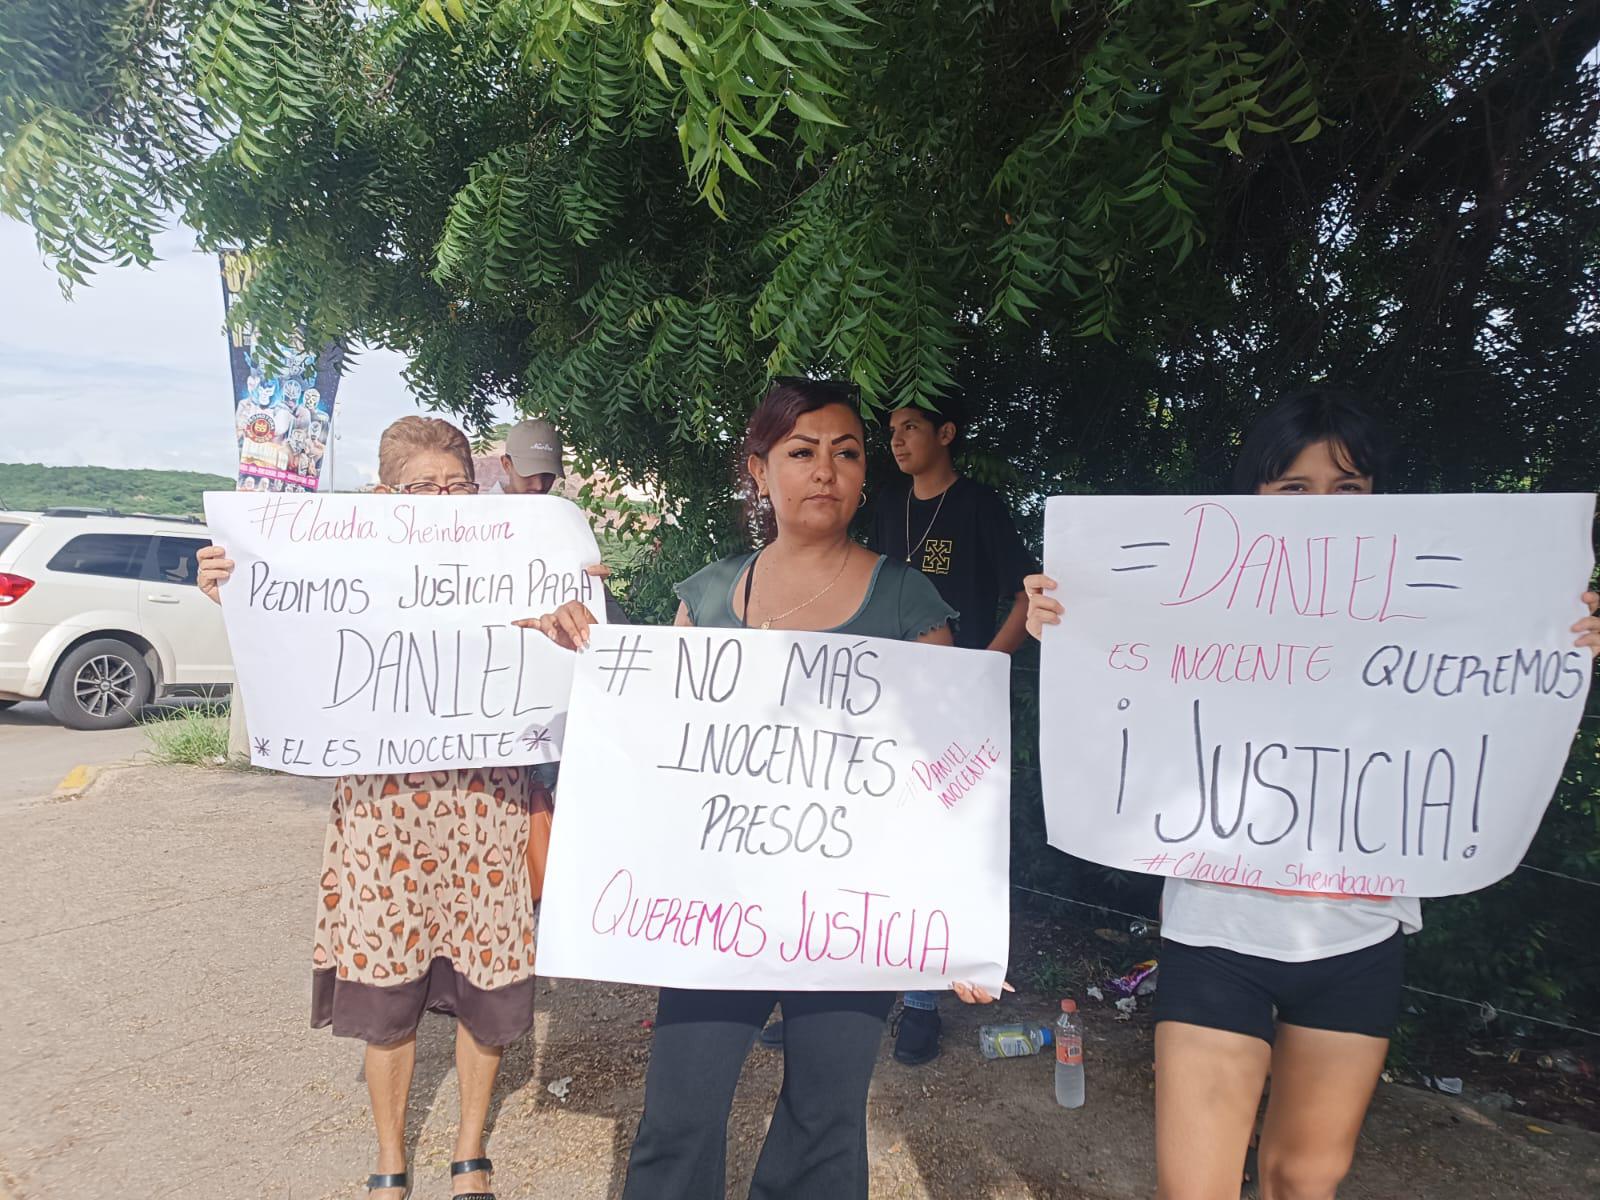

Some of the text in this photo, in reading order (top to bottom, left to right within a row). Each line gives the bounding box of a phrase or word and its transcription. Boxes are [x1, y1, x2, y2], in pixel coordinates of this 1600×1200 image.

[248, 497, 514, 544] #Claudia Sheinbaum
[250, 559, 592, 614] PEDIMOS JUSTICIA PARA
[322, 624, 553, 718] DANIEL
[675, 637, 742, 703] NO
[780, 640, 881, 715] MÁS
[1109, 642, 1583, 699] ES INOCENTE QUEREMOS
[282, 732, 515, 767] EL ES INOCENTE
[657, 722, 897, 796] INOCENTES
[700, 794, 852, 858] PRESOS
[1134, 852, 1263, 886] #Claudia
[592, 869, 950, 975] QUEREMOS JUSTICIA
